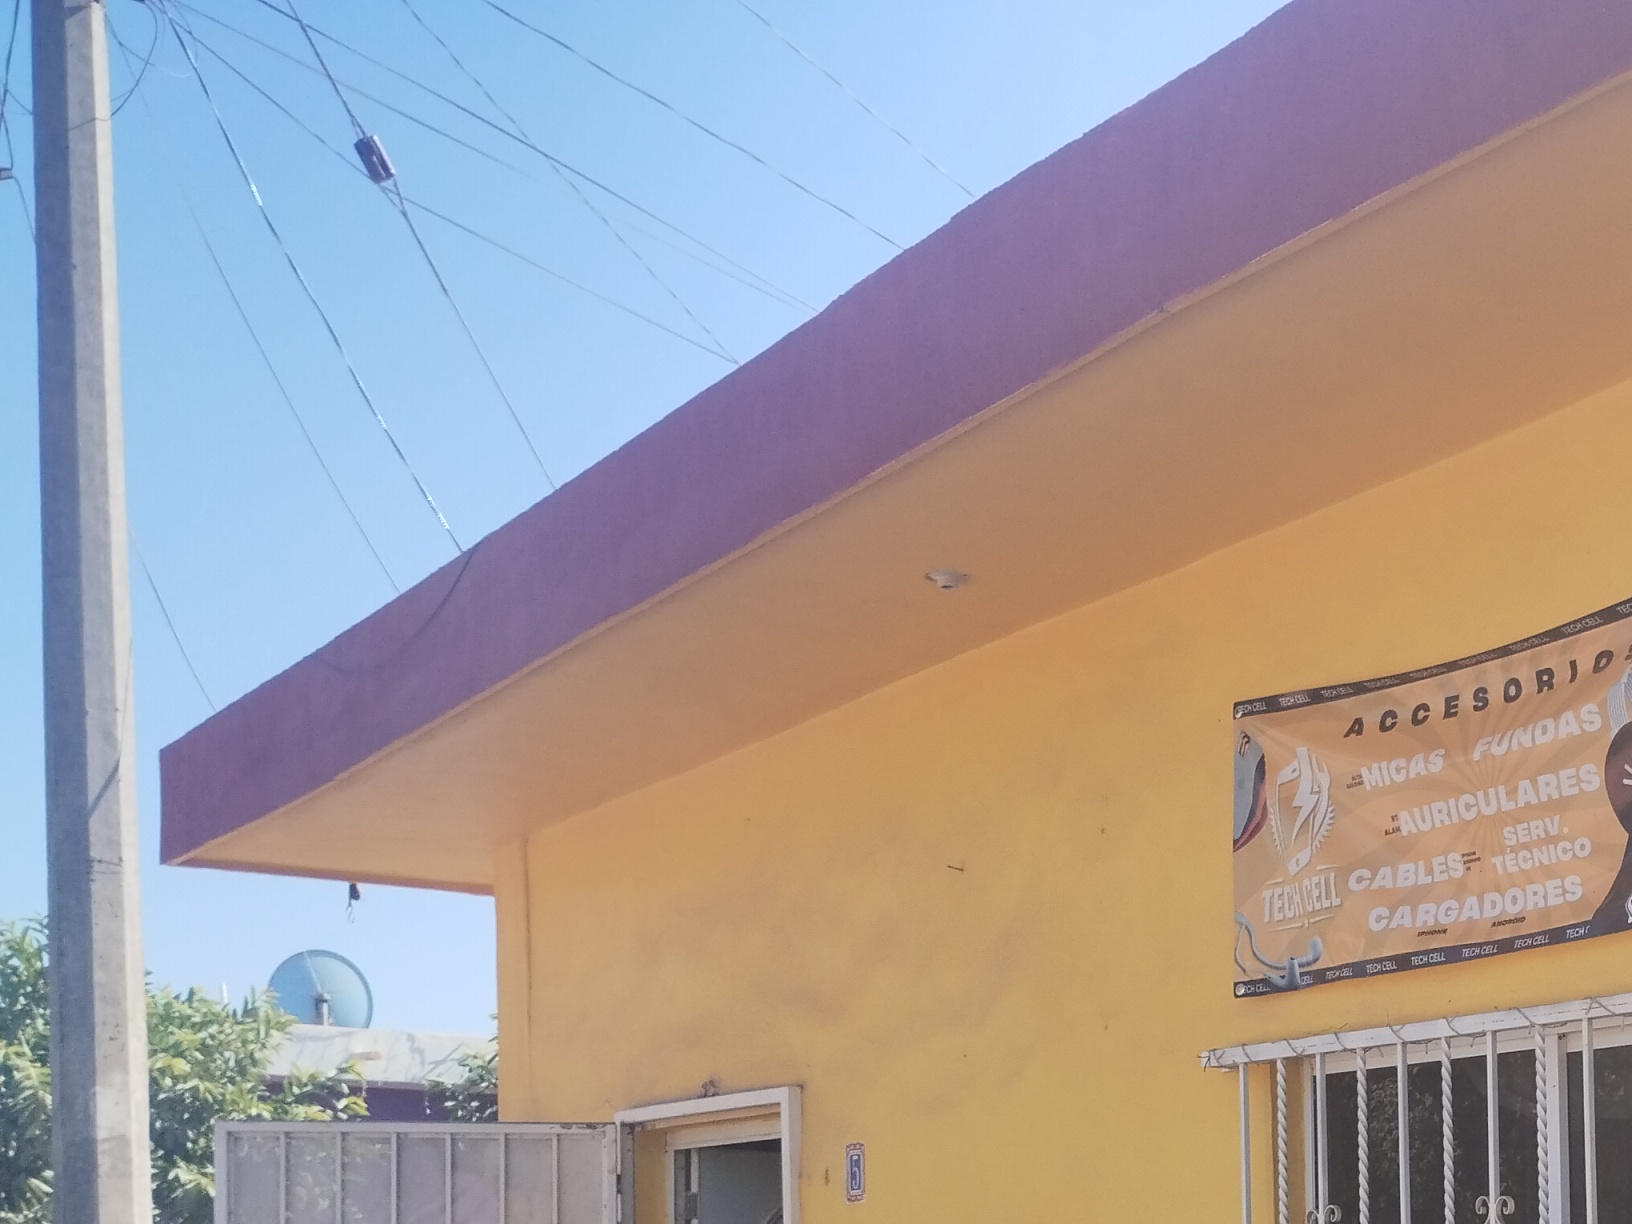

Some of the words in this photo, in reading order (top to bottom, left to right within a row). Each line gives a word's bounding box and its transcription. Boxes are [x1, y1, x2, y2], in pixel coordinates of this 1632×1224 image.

[1252, 701, 1268, 712] CELL
[1279, 698, 1295, 707] TECH
[1295, 694, 1311, 704] CELL
[1561, 622, 1583, 635] TECH
[1583, 616, 1603, 629] CELL
[1360, 748, 1446, 791] MICAS
[1472, 703, 1602, 761] FUNDAS
[1398, 763, 1601, 837] AURICULARES
[1347, 852, 1464, 891] CABLES
[1491, 837, 1592, 876] TÉCNICO
[1262, 882, 1304, 923] TECH
[1302, 872, 1342, 913] CELL
[1367, 875, 1583, 932] CARGADORES
[1366, 964, 1382, 974] TECH
[1382, 960, 1398, 971] CELL
[1411, 956, 1428, 966] TECH
[1429, 952, 1446, 963] CELL
[1462, 947, 1480, 958] TECH
[1480, 944, 1498, 955] CELL
[1514, 938, 1532, 949] TECH
[1532, 934, 1550, 945] CELL
[1565, 927, 1584, 939] TECH
